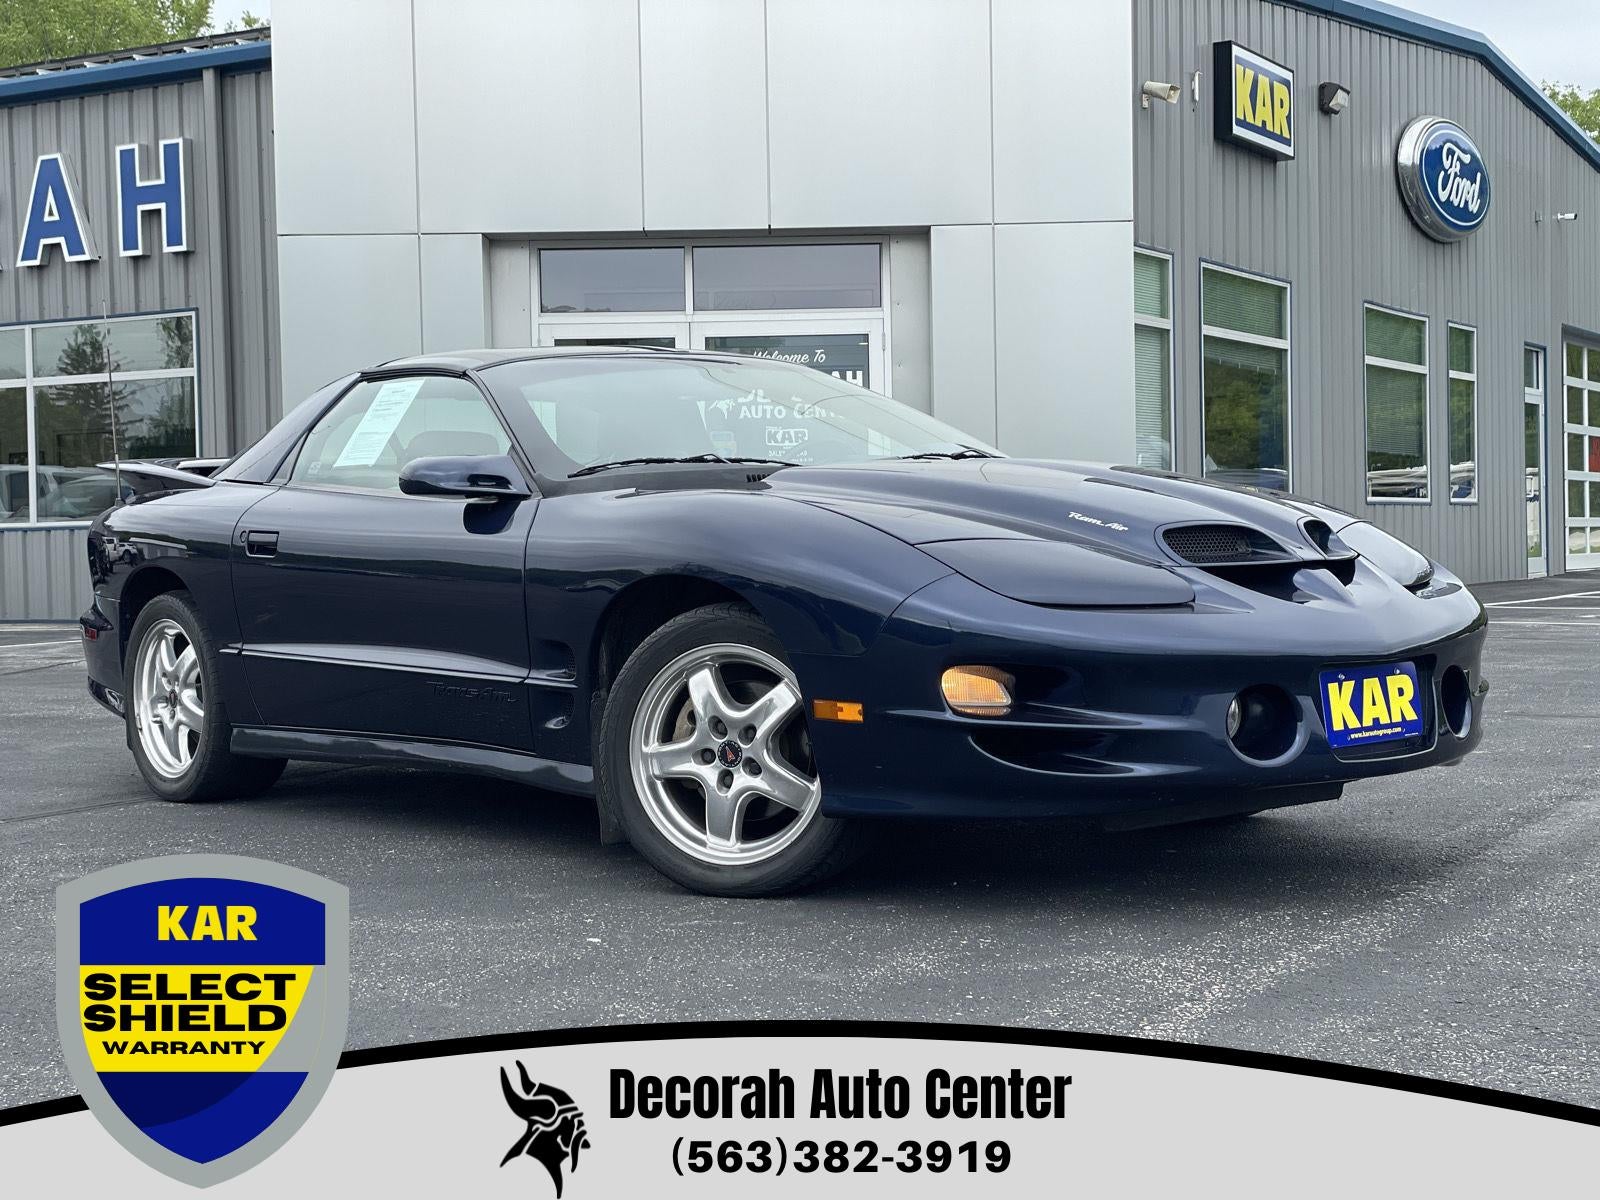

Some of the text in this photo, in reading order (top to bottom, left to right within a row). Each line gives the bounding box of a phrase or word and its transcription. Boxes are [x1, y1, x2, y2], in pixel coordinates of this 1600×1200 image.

[1236, 63, 1290, 140] KAR
[1438, 142, 1481, 214] Ford
[0, 137, 192, 268] AH
[813, 349, 826, 363] To
[739, 404, 787, 419] AUTO
[766, 429, 808, 445] KAR
[1068, 511, 1105, 527] Ram
[1327, 674, 1418, 731] KAR
